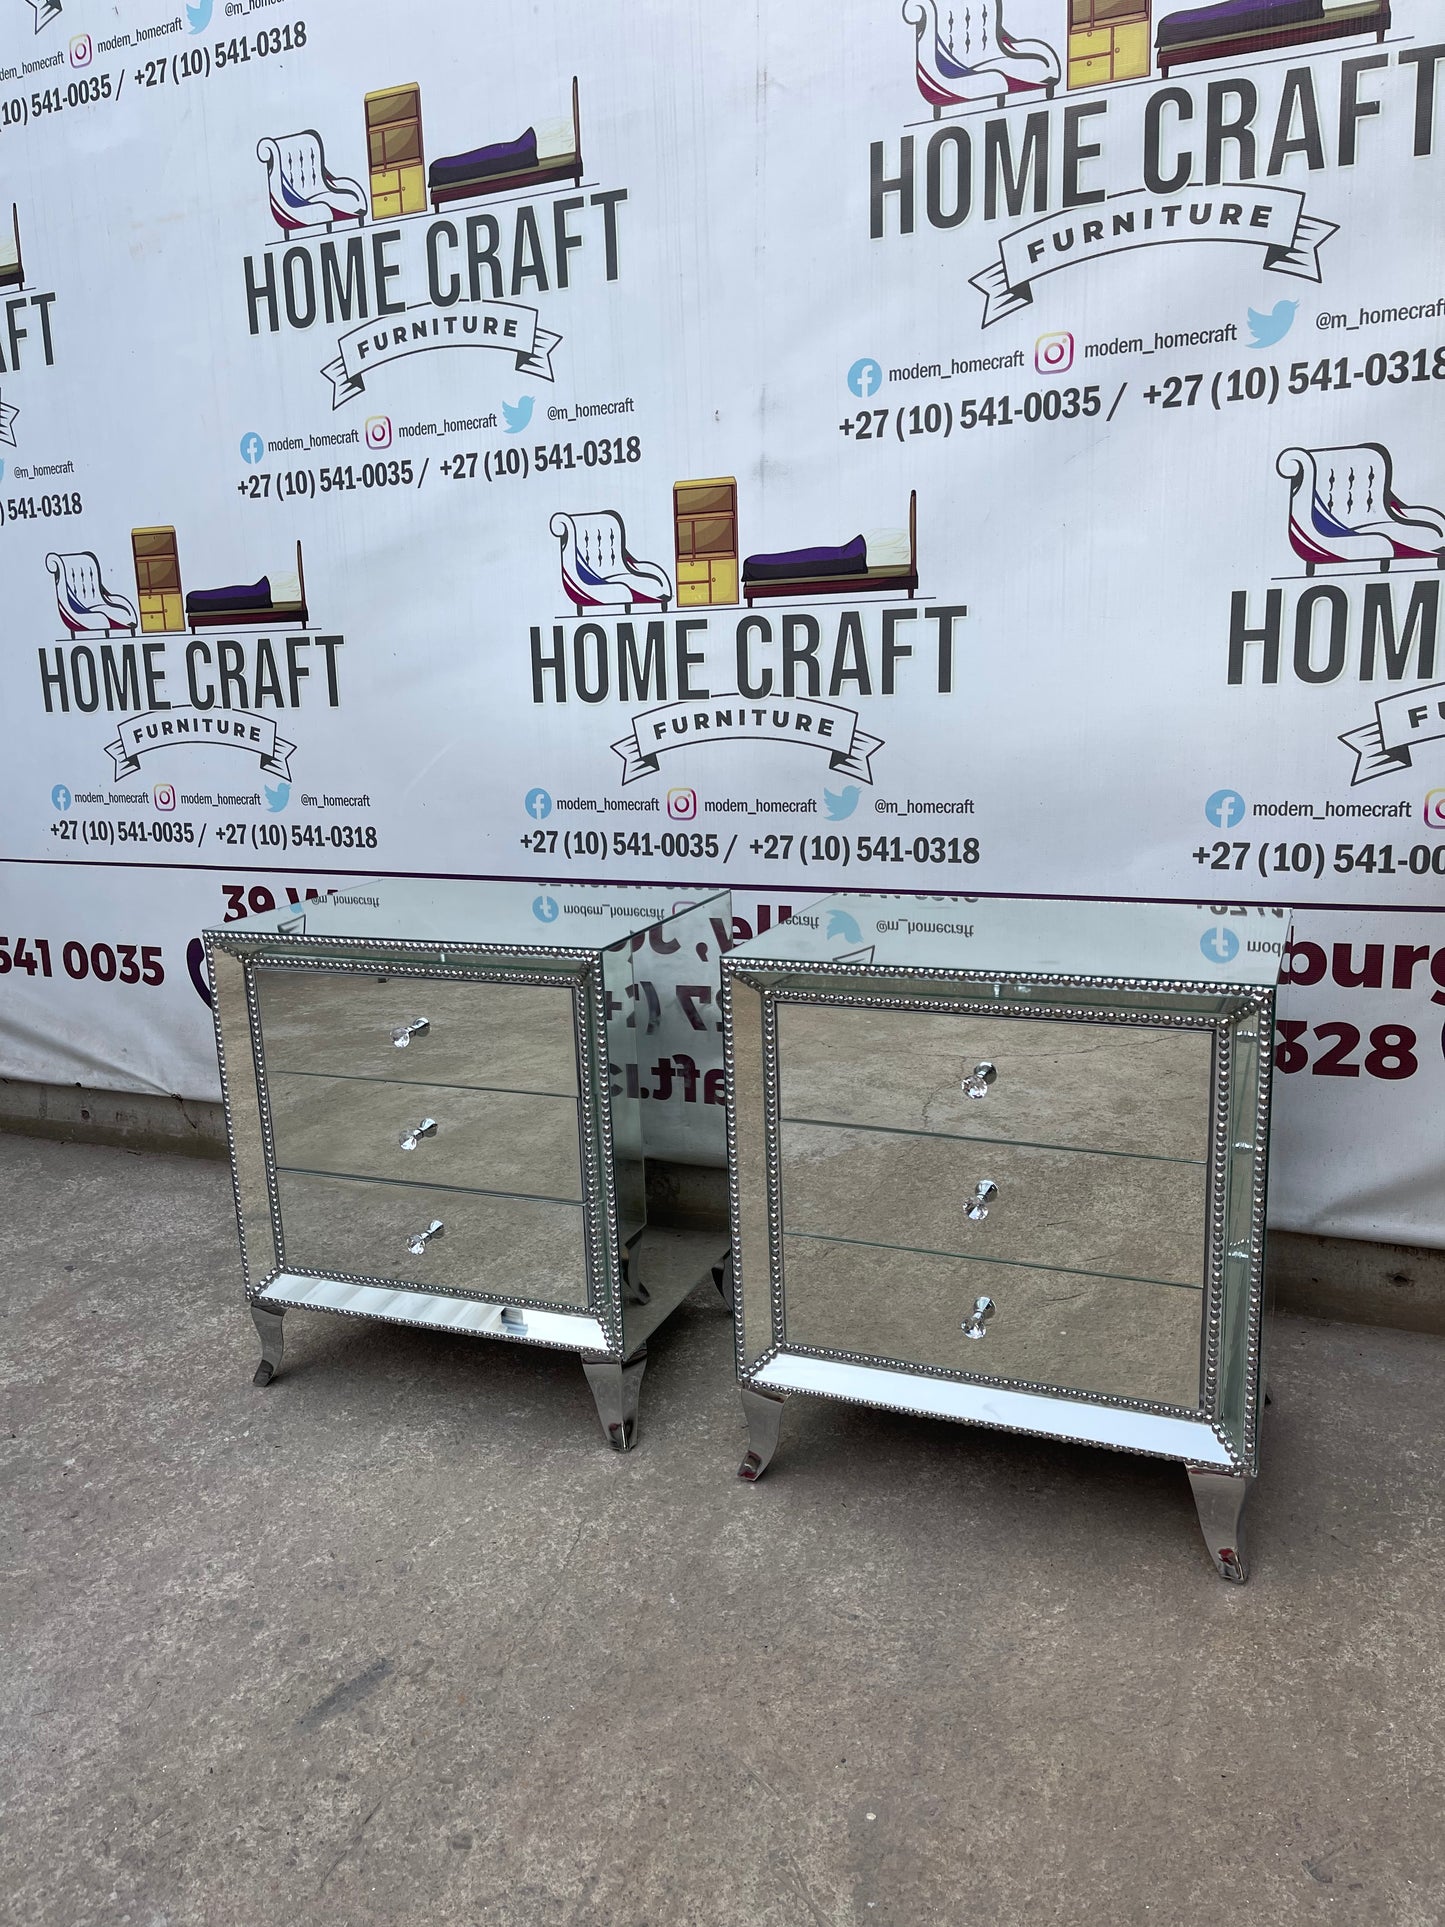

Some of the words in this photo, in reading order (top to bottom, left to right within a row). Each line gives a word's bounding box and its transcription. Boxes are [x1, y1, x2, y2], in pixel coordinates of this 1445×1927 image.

[31, 73, 112, 118] 541-0035
[134, 57, 167, 87] +27
[172, 46, 211, 85] (10)
[215, 21, 307, 68] 541-0318
[870, 99, 1108, 239] HOME
[1143, 43, 1445, 194] CRAFT
[1026, 203, 1273, 263] FURNITURE
[243, 230, 406, 335] HOME
[426, 188, 628, 307] CRAFT
[357, 315, 518, 360] FURNITURE
[889, 350, 1025, 382] modern_homecraft
[1084, 323, 1237, 358] modern_homecraft
[1315, 298, 1445, 331] @m_homecraf
[547, 397, 635, 422] @m_homecraft
[839, 409, 889, 440] +27
[896, 402, 952, 442] (10)
[960, 385, 1102, 429] 541-0035
[1143, 374, 1203, 409] +27
[1211, 366, 1279, 410] (10)
[1288, 346, 1445, 394] 541-0318
[13, 461, 75, 480] @m_homecraft
[238, 474, 271, 499] +27
[276, 470, 316, 502] (10)
[319, 459, 414, 492] 541-0035
[440, 452, 478, 480] +27
[484, 448, 529, 482] (10)
[534, 436, 641, 472] 541-0318
[8, 492, 83, 521] 541-0318
[530, 618, 710, 704] HOME
[736, 605, 968, 700] CRAFT
[1227, 580, 1440, 685] HOM
[38, 642, 171, 713] HOME
[185, 635, 344, 711] CRAFT
[133, 718, 261, 744] FURNITURE
[653, 709, 835, 740] FURNITURE
[301, 793, 371, 809] @m_homecraft
[874, 799, 975, 816] @m_homecraft
[1253, 801, 1412, 820] modern_homecraft
[50, 820, 77, 840] +27
[82, 820, 114, 846] (10)
[117, 821, 195, 843] 541-0035
[215, 823, 247, 845] +27
[251, 824, 288, 850] (10)
[291, 825, 378, 849] 541-0318
[520, 830, 559, 853] +27
[564, 831, 608, 860] (10)
[613, 832, 719, 858] 541-0035
[750, 835, 794, 860] +27
[800, 835, 851, 867] (10)
[857, 836, 980, 864] 541-0318
[1193, 842, 1251, 871] +27
[1258, 843, 1325, 879] (10)
[63, 941, 165, 987] 0035
